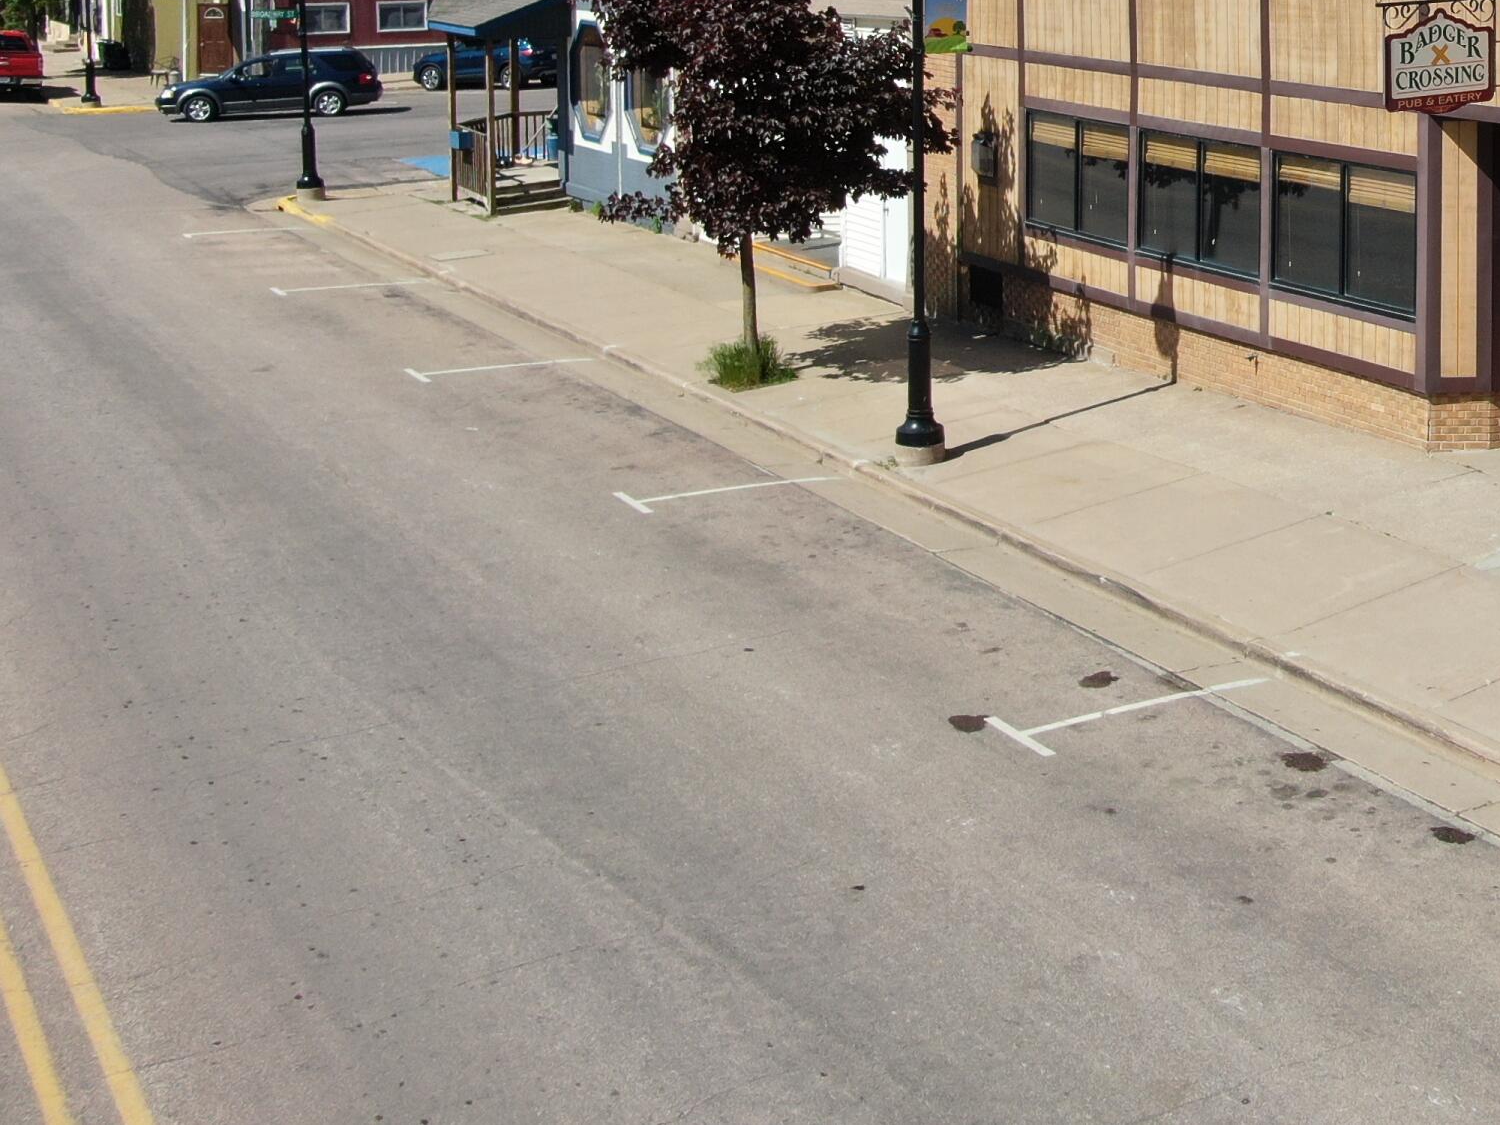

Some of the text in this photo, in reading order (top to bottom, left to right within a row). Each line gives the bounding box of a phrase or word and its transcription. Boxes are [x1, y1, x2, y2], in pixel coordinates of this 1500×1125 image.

[1400, 24, 1482, 64] BADGER
[1395, 63, 1485, 91] CROSSING
[1397, 92, 1482, 109] PUB & EATERY
